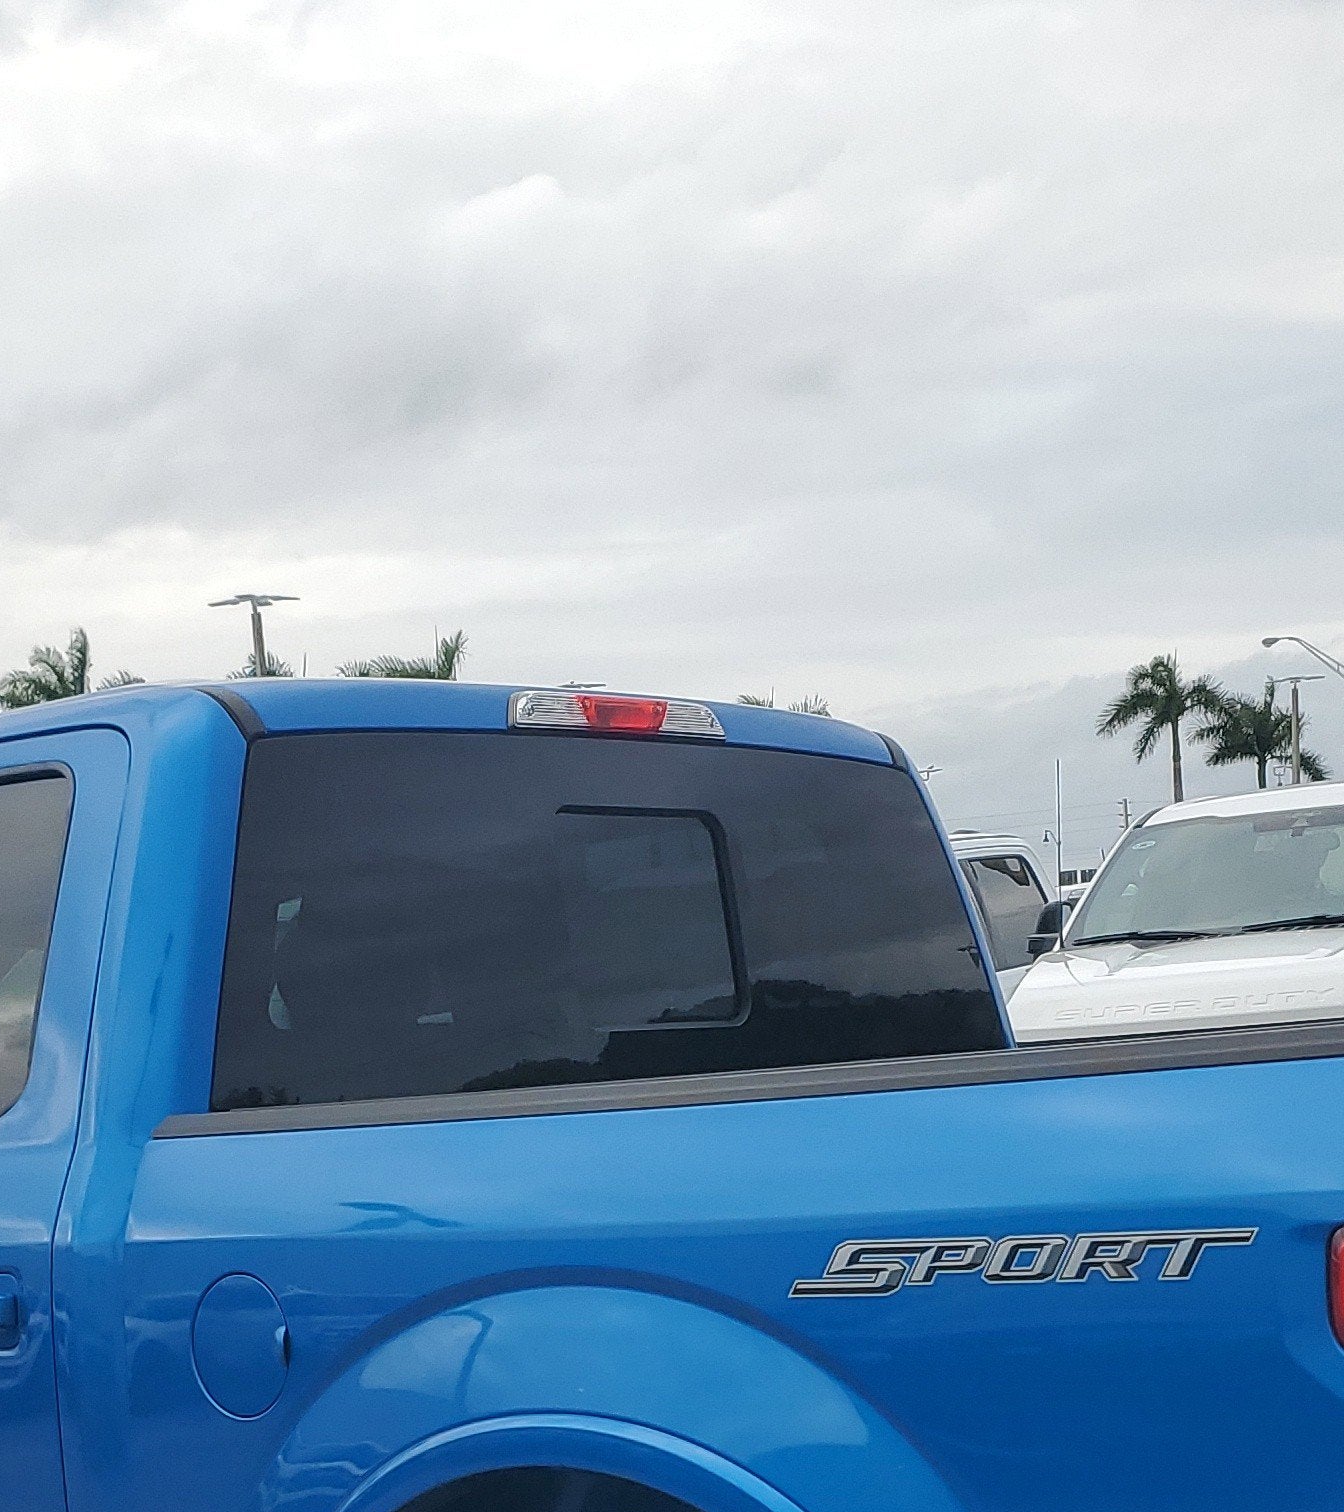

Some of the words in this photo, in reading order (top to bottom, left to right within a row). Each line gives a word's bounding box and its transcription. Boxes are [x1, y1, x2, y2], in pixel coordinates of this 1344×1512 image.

[1054, 999, 1202, 1021] SUPER
[1211, 987, 1336, 1009] DUTY
[787, 1226, 1260, 1298] SPORT
